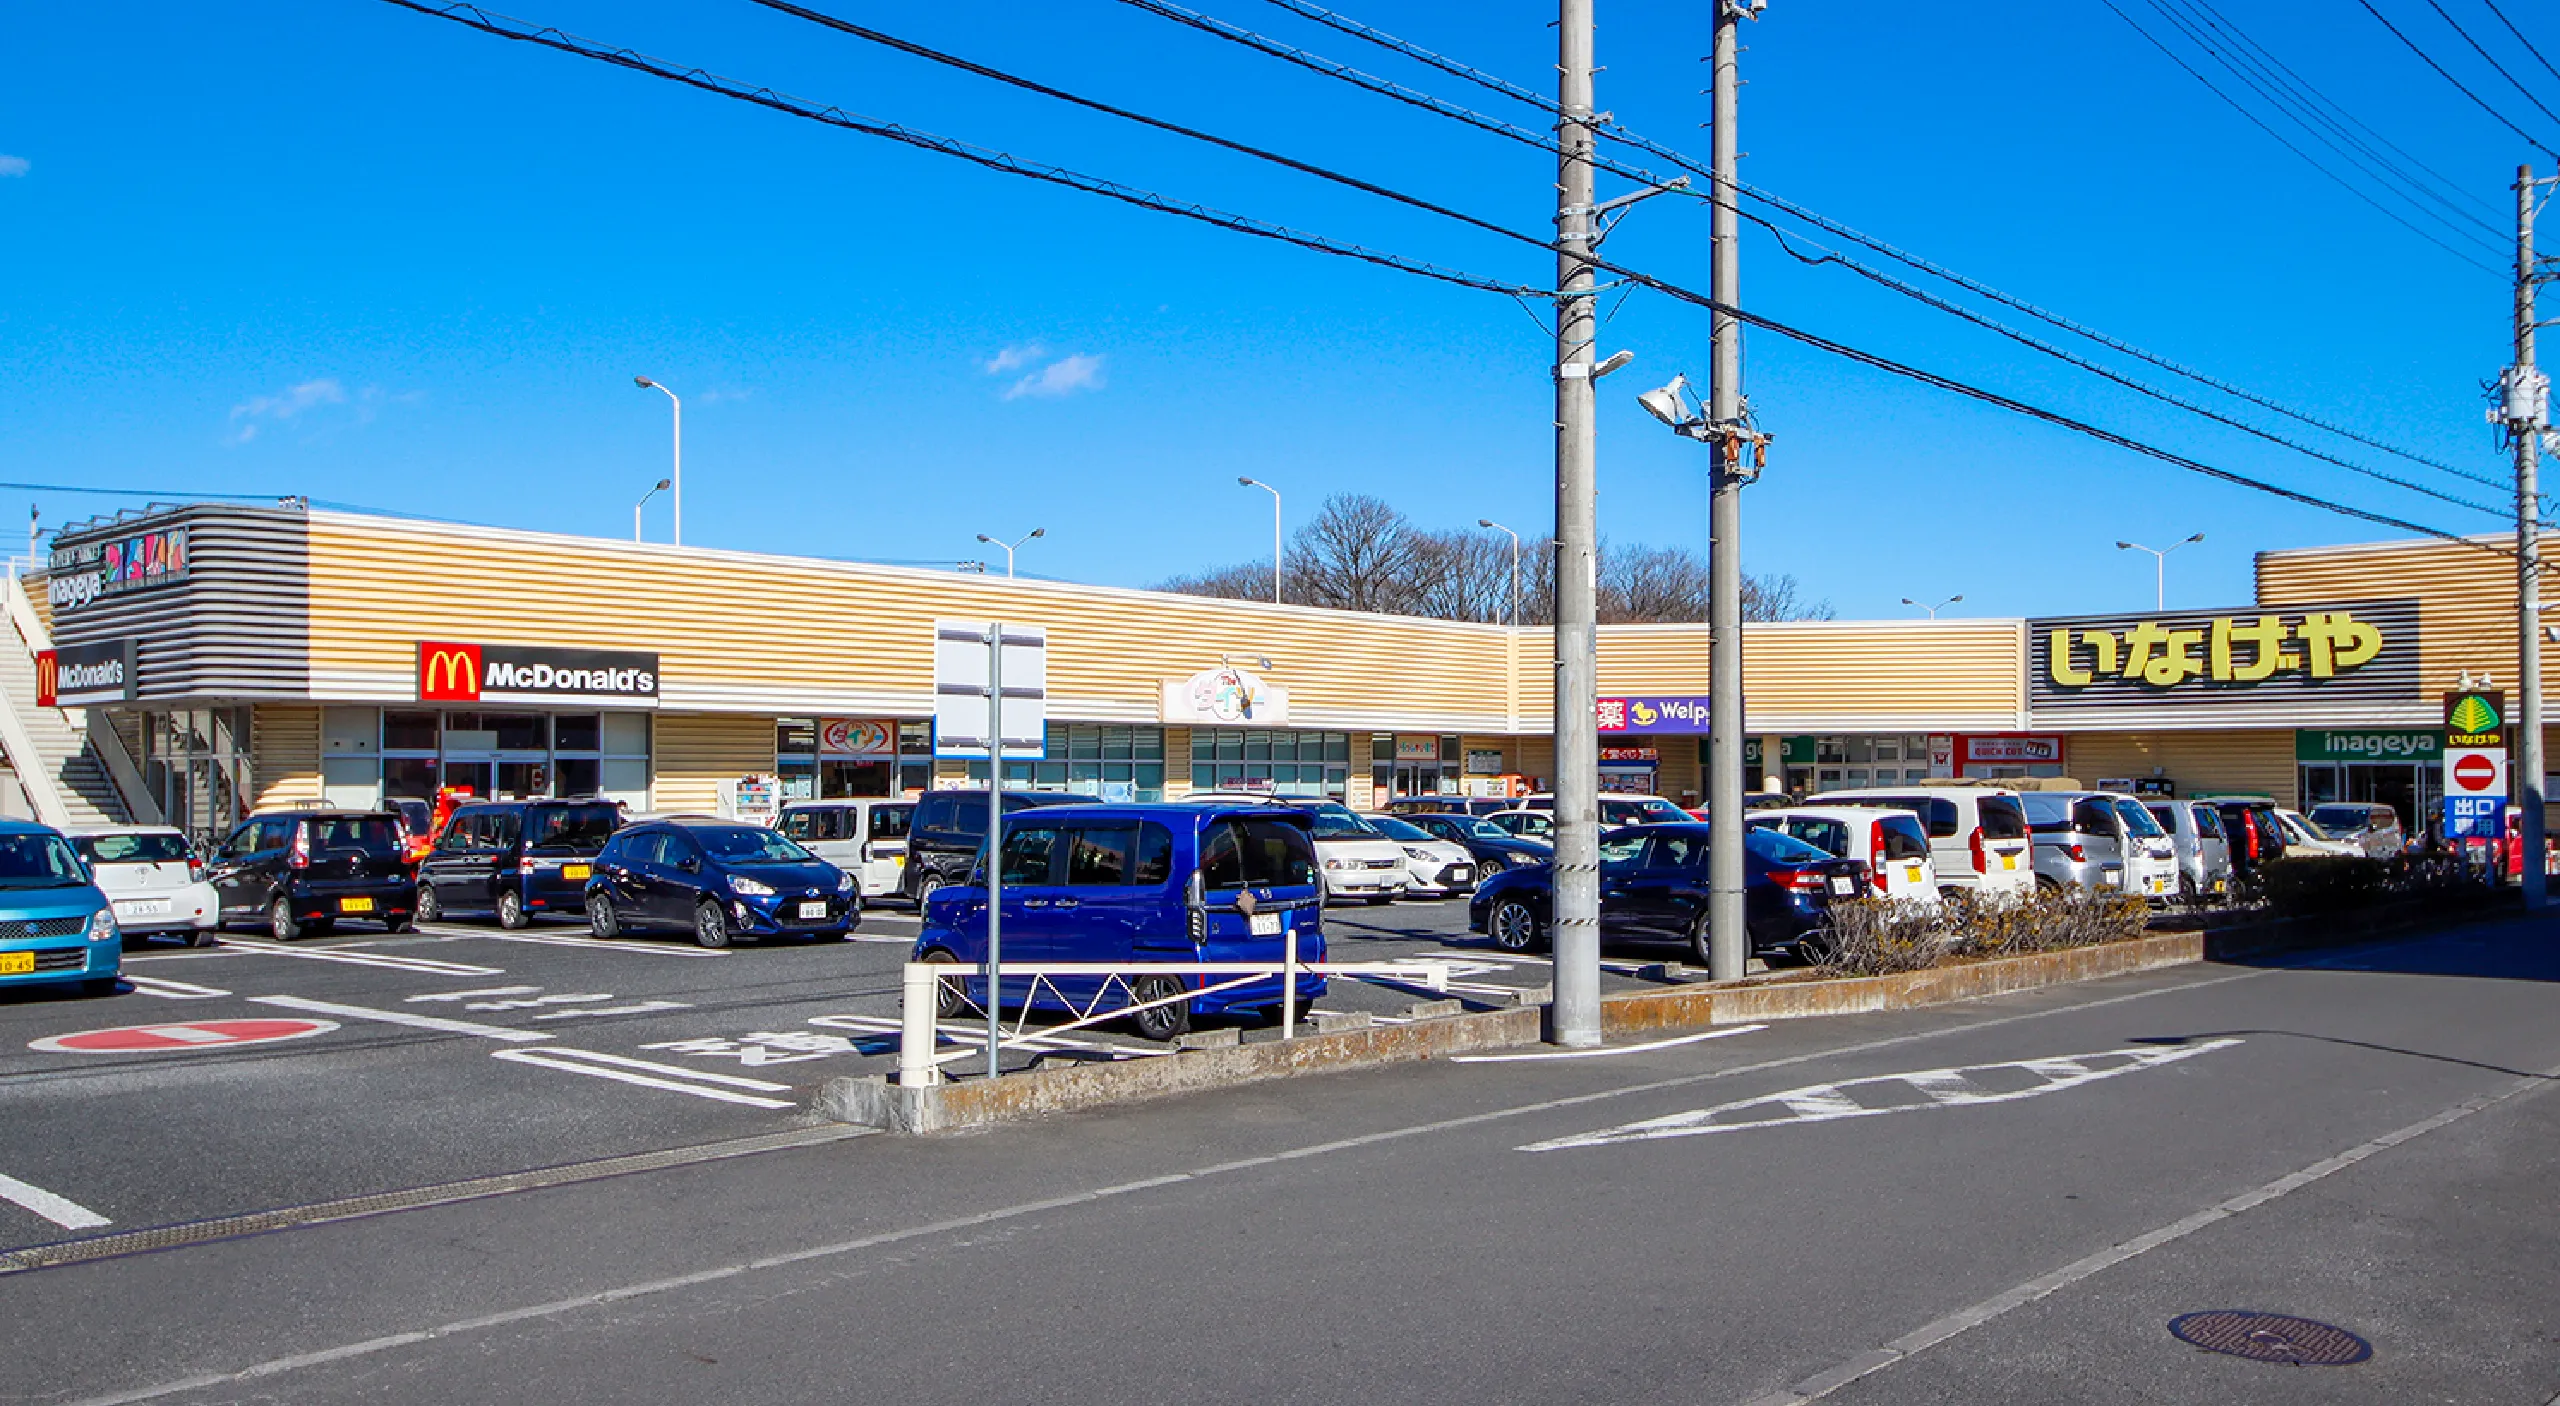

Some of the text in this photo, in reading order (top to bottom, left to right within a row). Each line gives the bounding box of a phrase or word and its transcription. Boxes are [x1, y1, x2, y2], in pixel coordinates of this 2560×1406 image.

[2051, 612, 2383, 686] いなげや
[57, 658, 124, 689] McDonald's
[485, 662, 654, 691] McDonald's
[1598, 701, 1625, 729] 薬
[2324, 731, 2435, 755] inageya
[2454, 798, 2496, 816] 出口
